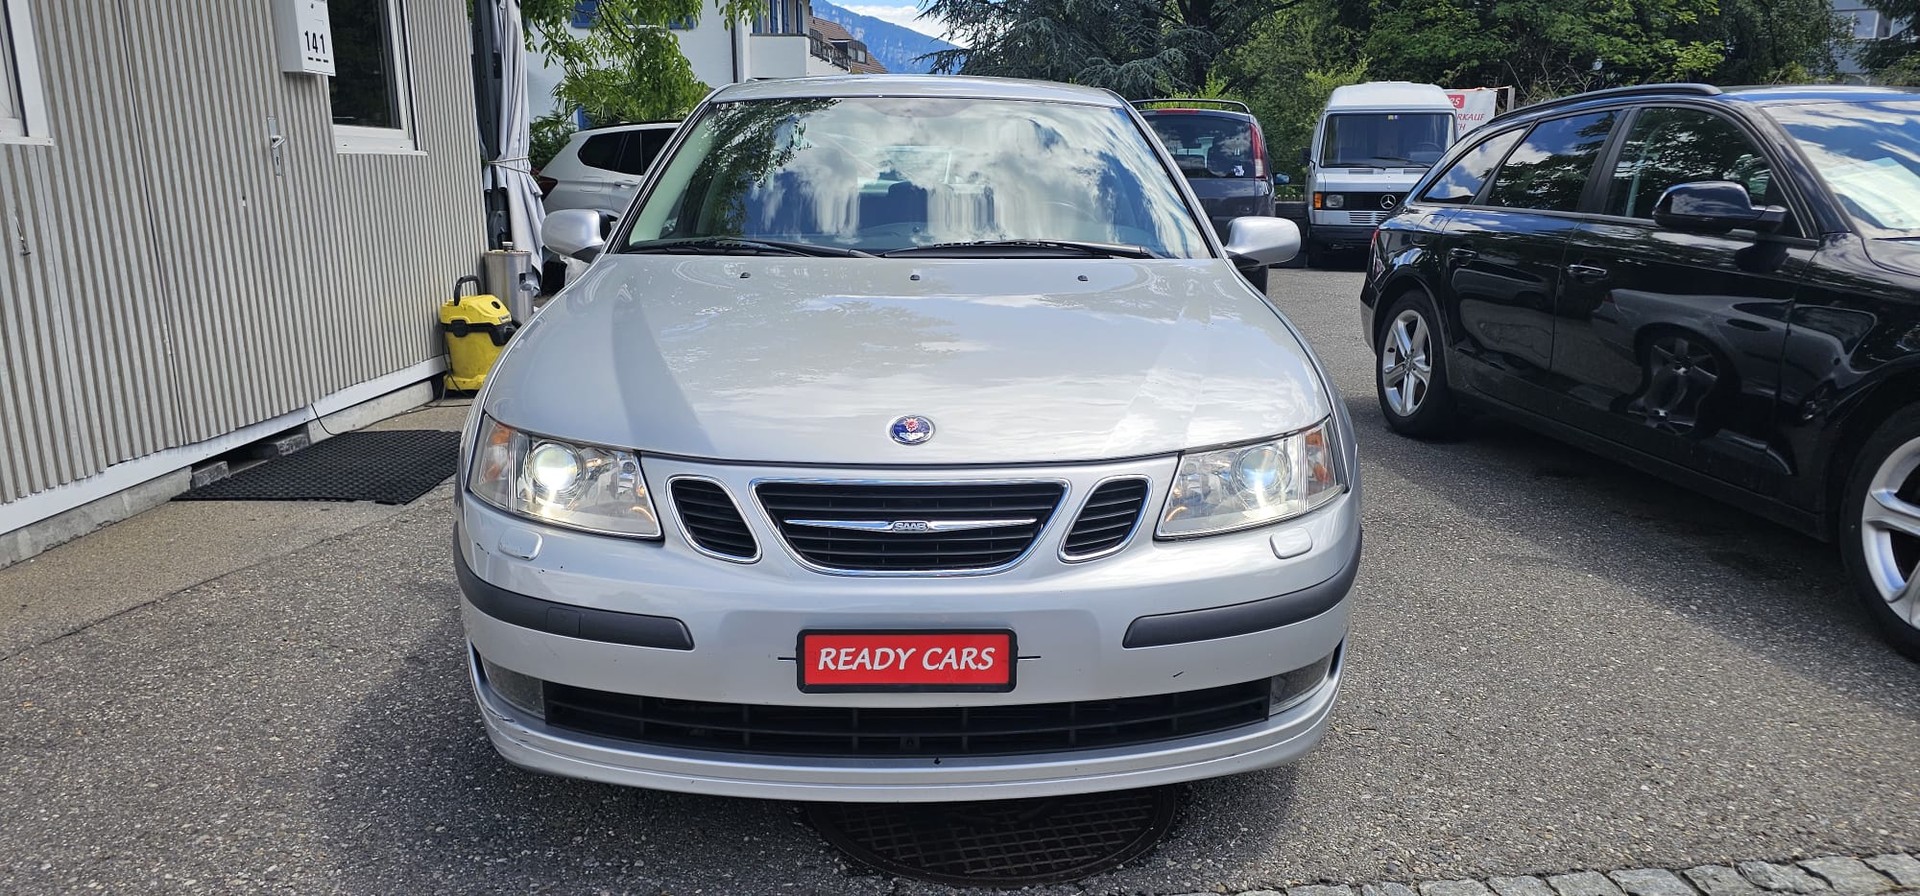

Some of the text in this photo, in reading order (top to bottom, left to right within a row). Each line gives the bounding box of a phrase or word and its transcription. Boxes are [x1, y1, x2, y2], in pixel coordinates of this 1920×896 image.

[304, 30, 326, 54] 141
[894, 522, 927, 531] SAAB
[818, 647, 996, 671] READY CARS
